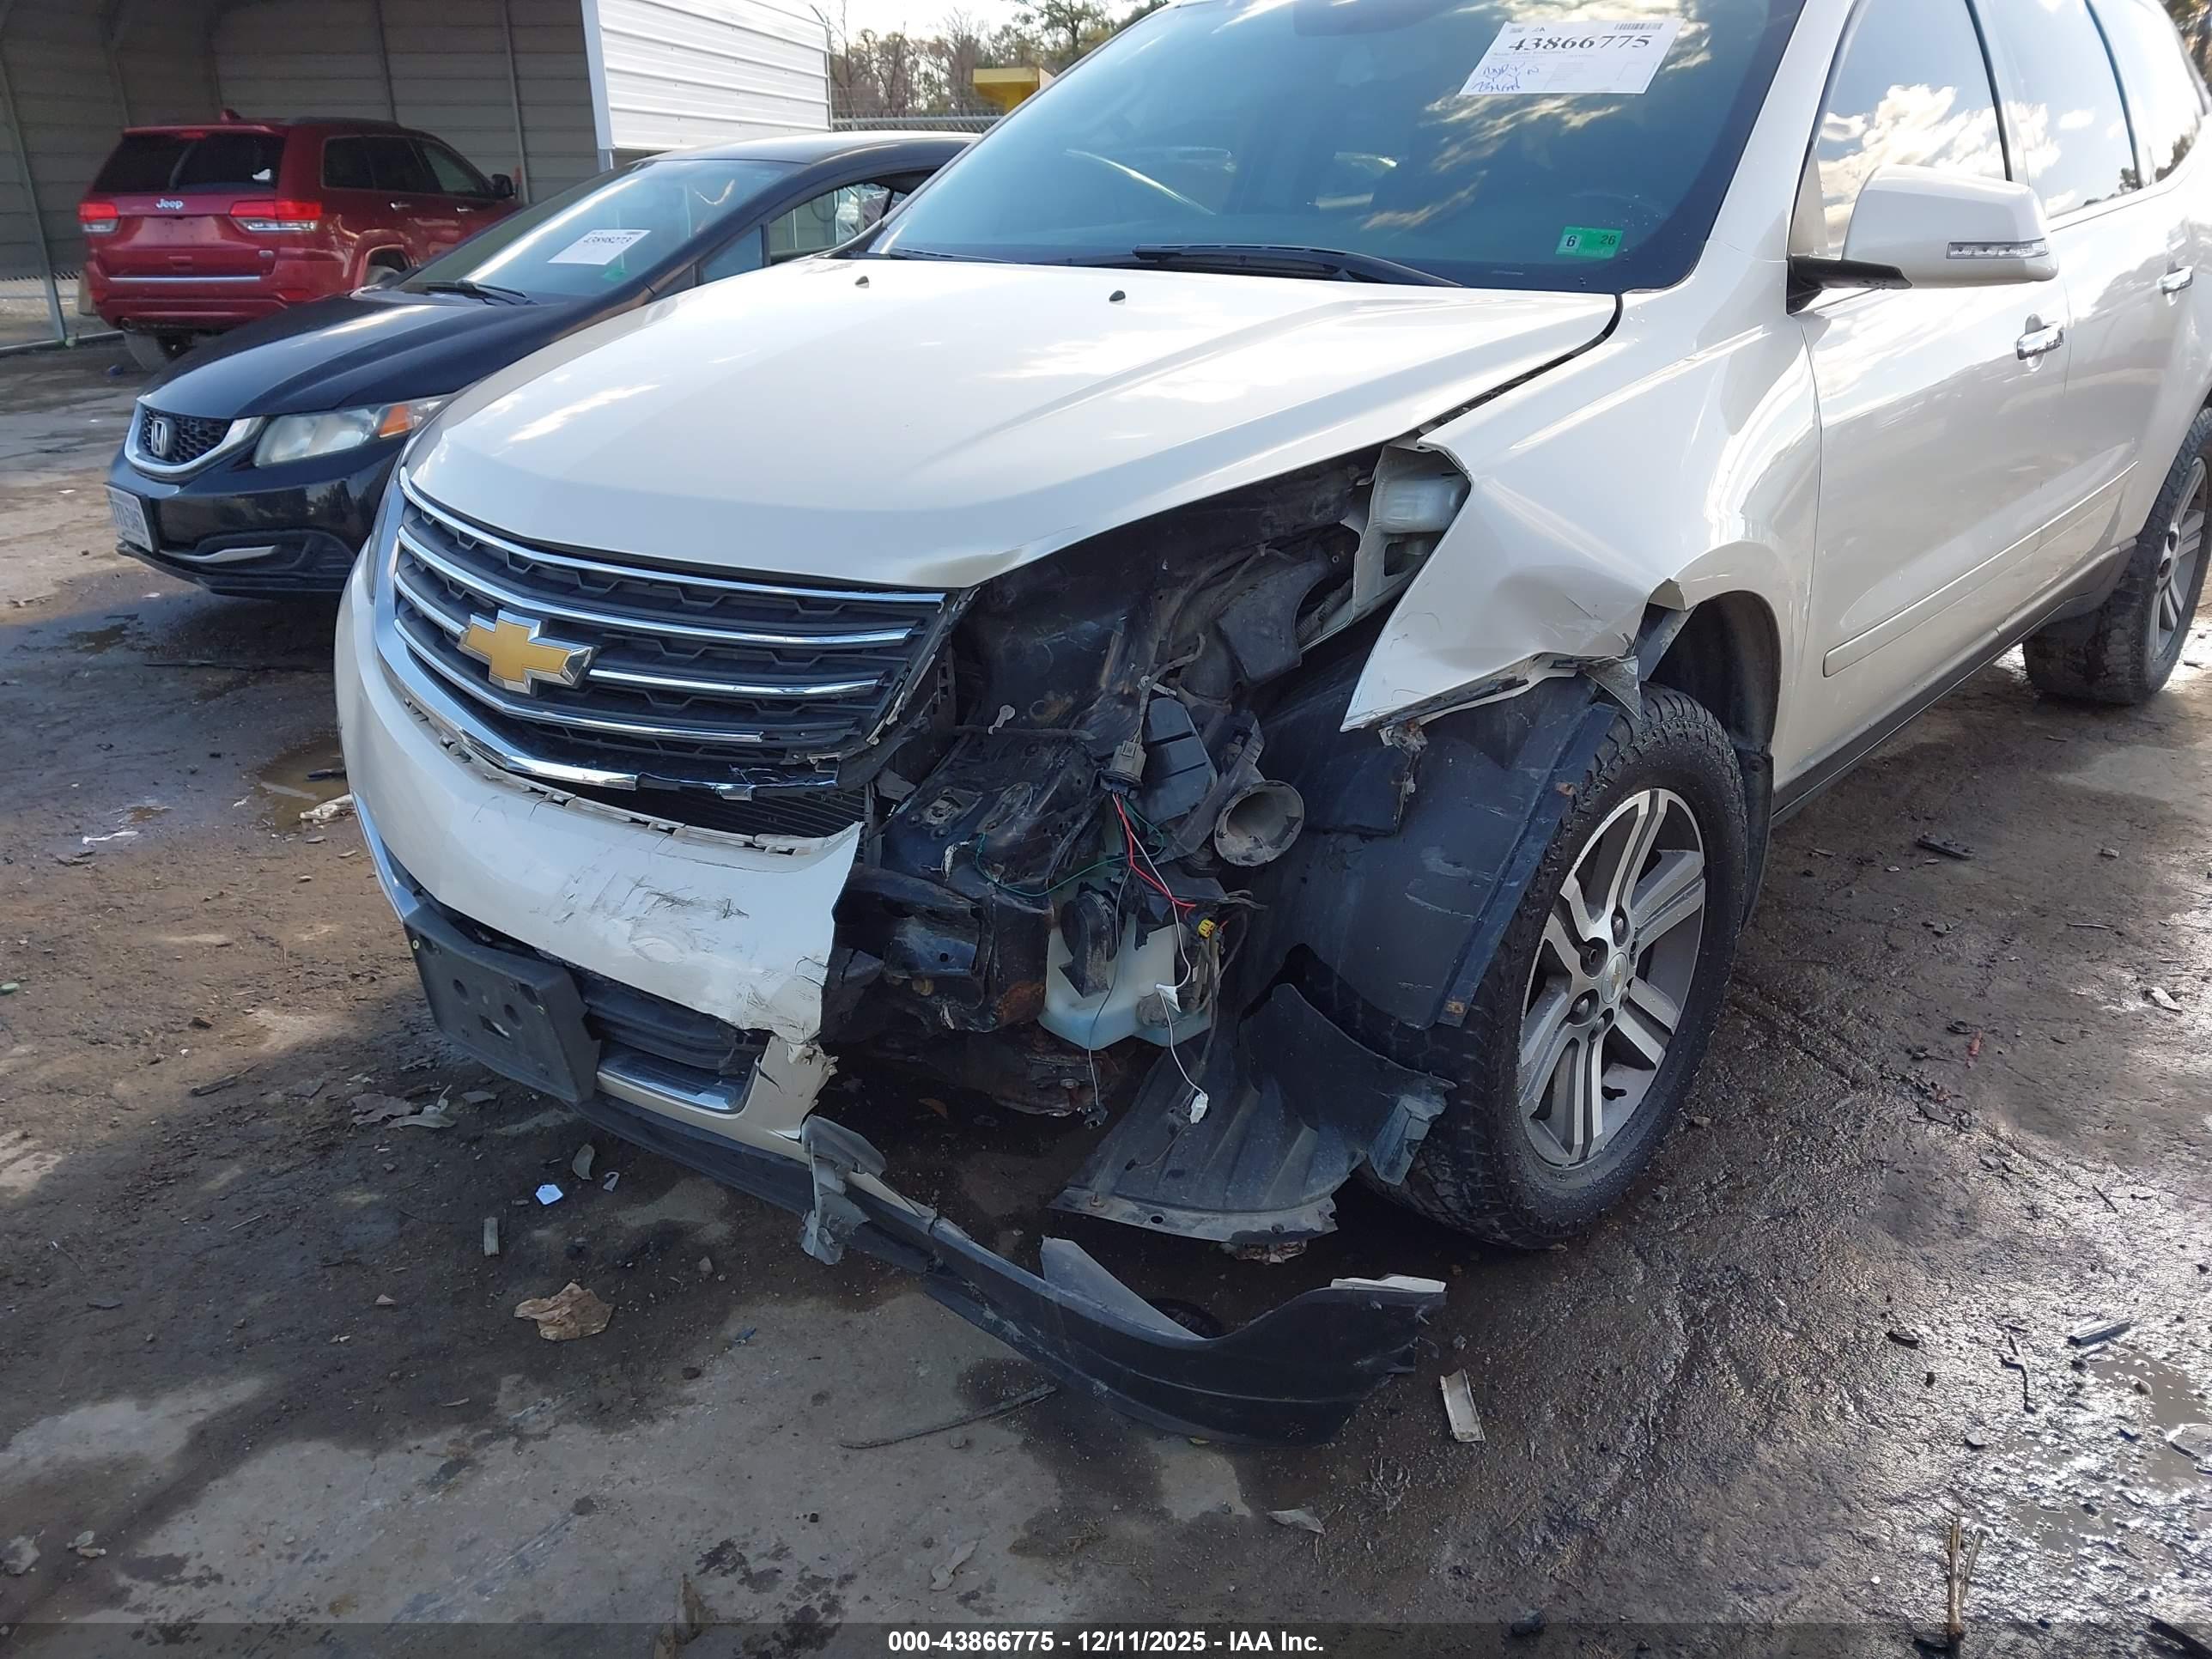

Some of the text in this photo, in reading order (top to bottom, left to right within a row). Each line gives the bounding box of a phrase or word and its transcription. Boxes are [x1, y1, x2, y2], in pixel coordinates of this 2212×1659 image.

[1508, 34, 1653, 51] 43866775
[155, 198, 184, 210] Jeep
[1566, 234, 1616, 246] 6 26
